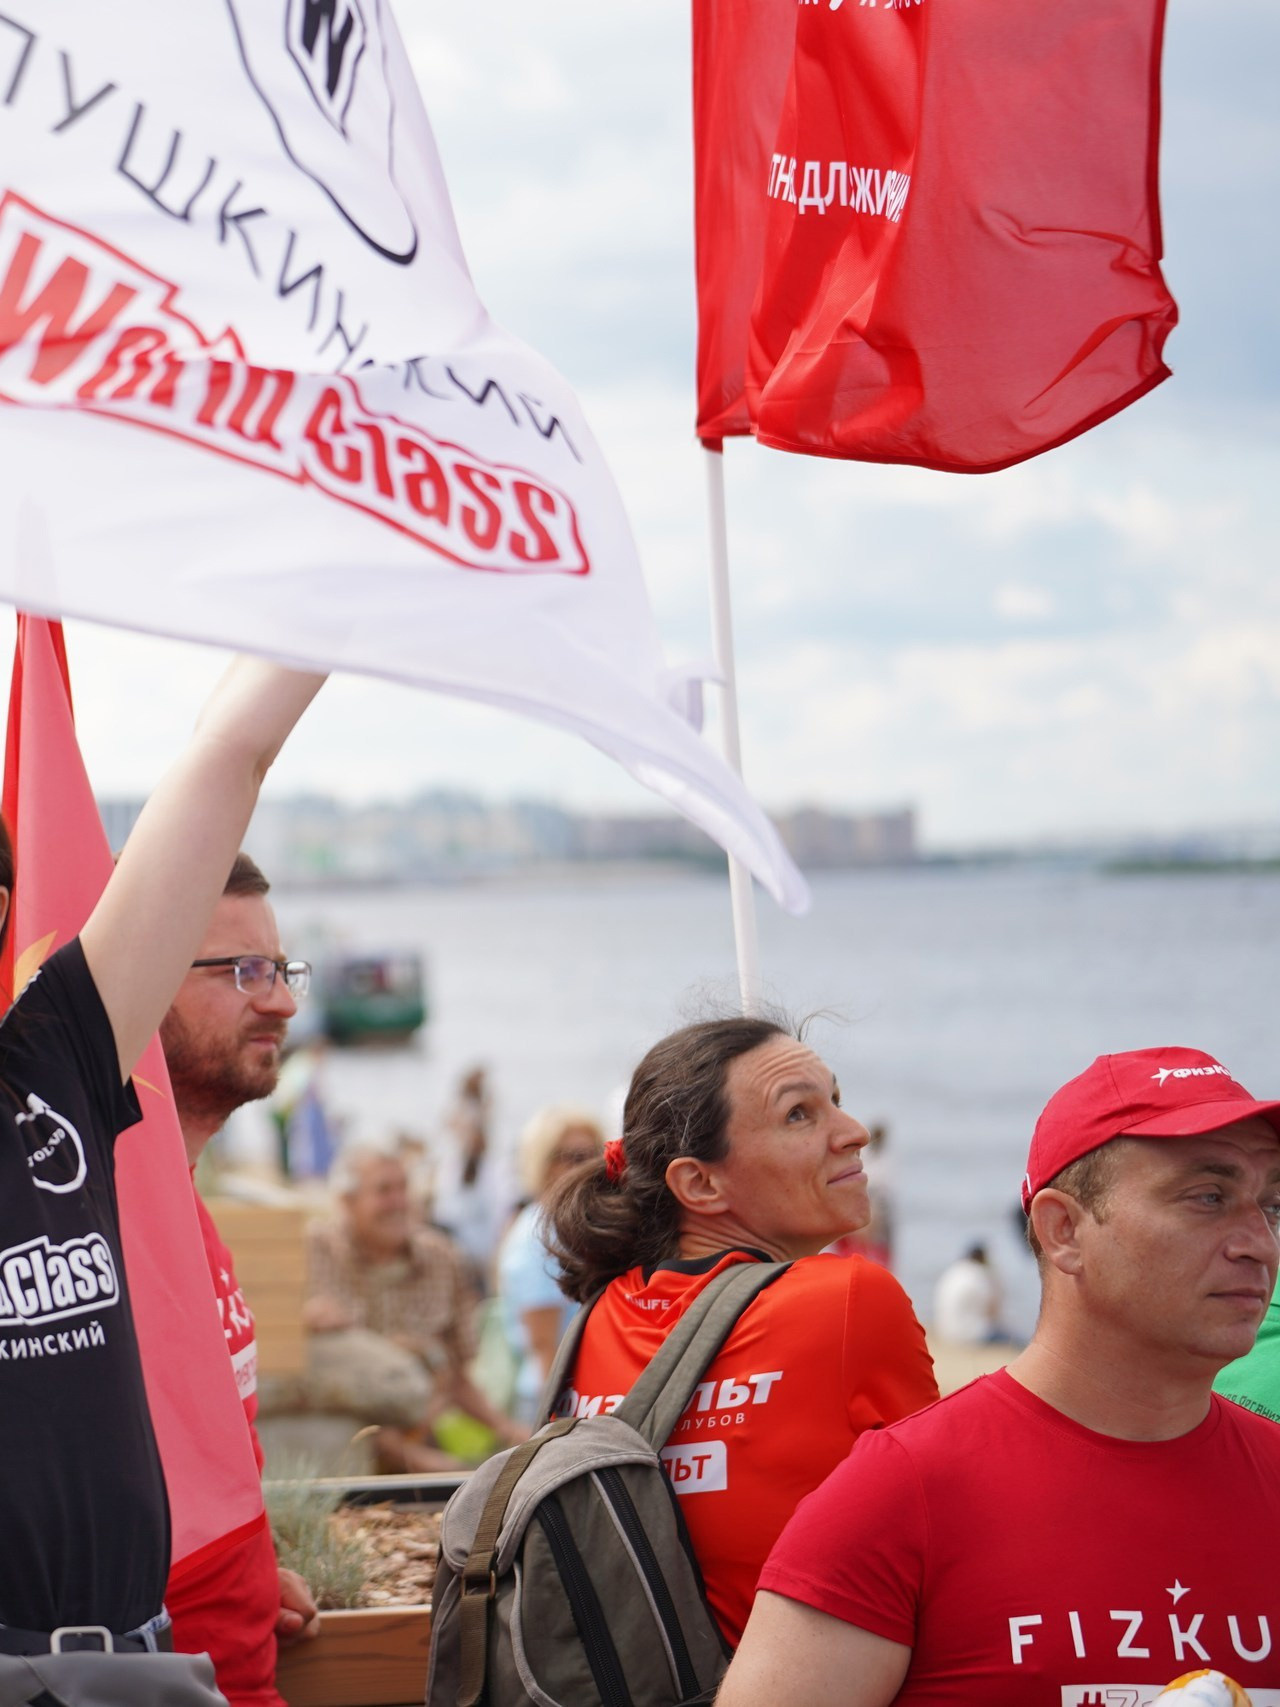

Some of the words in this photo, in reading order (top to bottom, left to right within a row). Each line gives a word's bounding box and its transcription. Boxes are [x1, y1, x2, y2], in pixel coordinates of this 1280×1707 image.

[303, 387, 561, 562] Class
[4, 1243, 115, 1316] Class
[674, 1412, 745, 1433] ЛУБОВ
[1008, 1609, 1272, 1665] FIZKU
